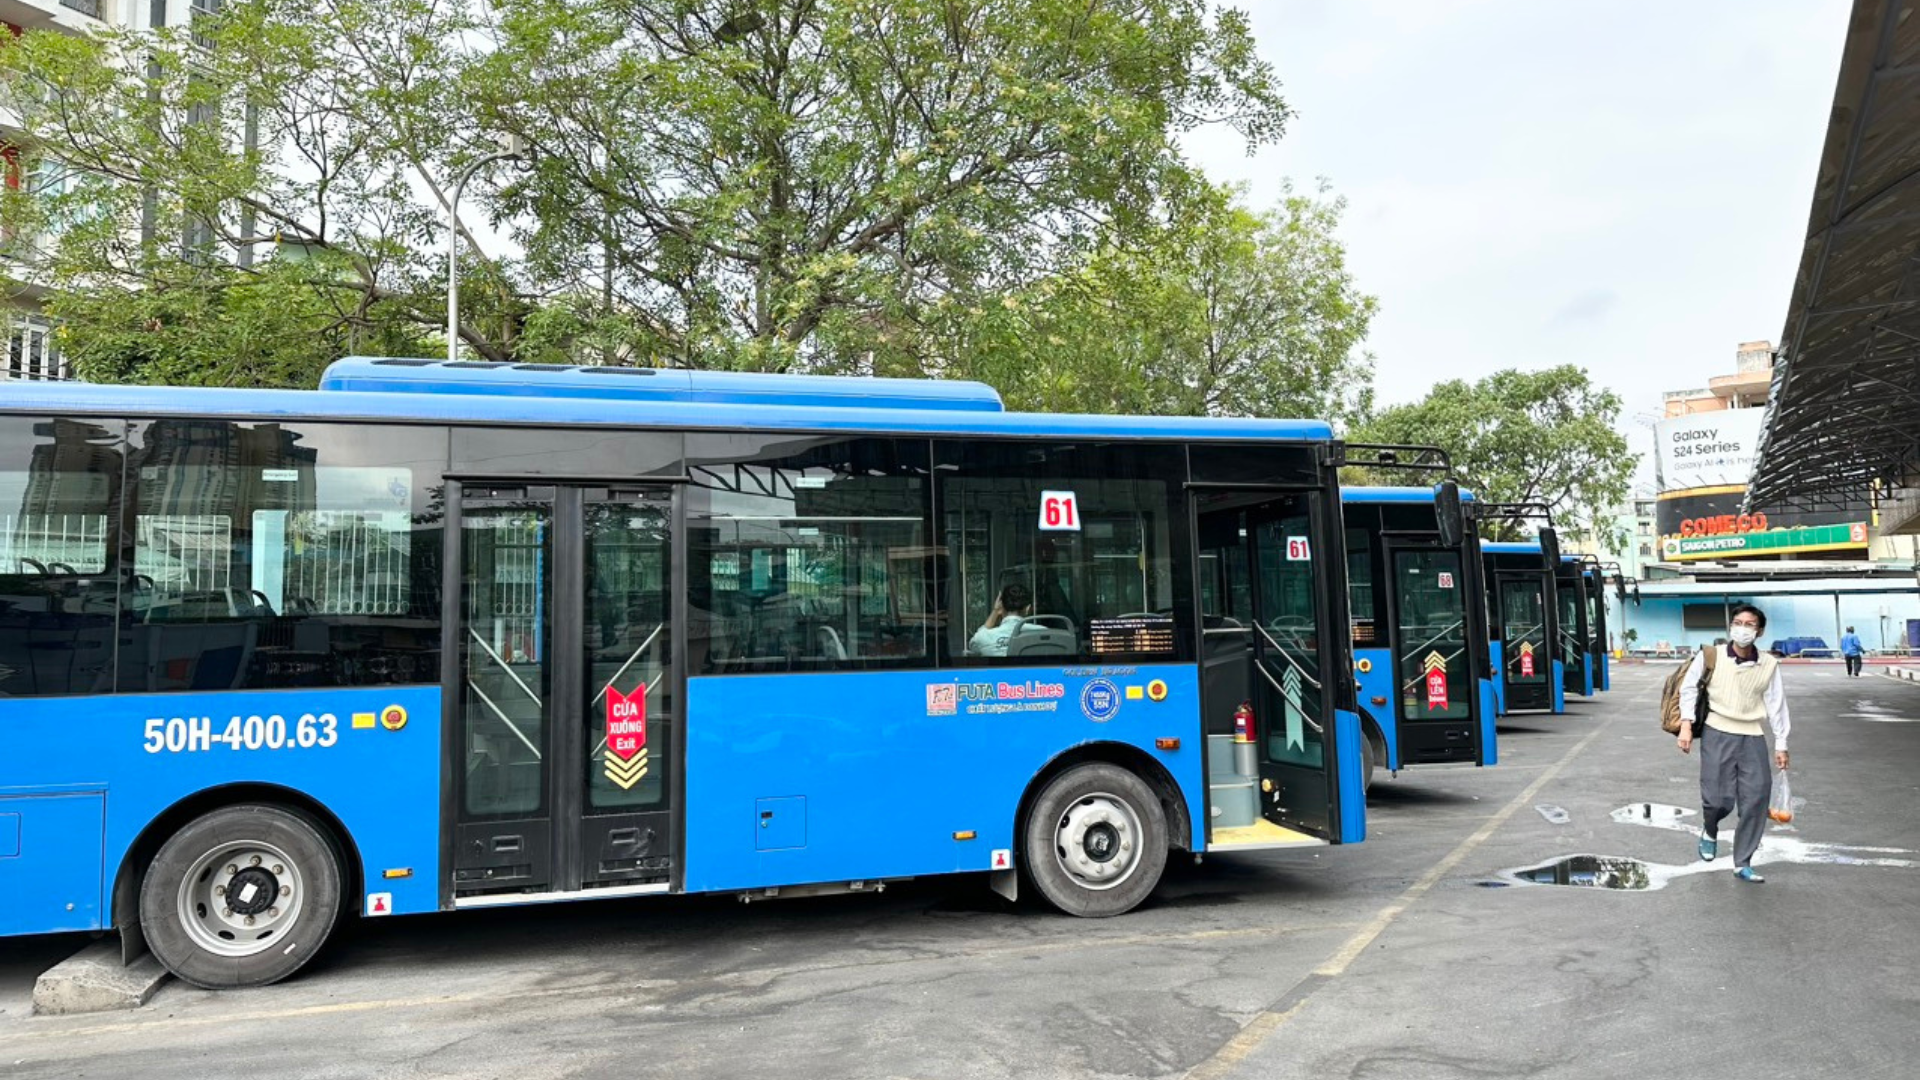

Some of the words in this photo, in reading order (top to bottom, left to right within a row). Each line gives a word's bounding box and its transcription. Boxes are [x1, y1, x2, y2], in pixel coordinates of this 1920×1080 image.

[1672, 429, 1718, 443] Galaxy
[1674, 445, 1692, 458] S24
[1695, 441, 1741, 455] Series
[1674, 460, 1703, 471] Galaxy
[1045, 497, 1074, 527] 61
[1680, 511, 1768, 537] COMECO
[1289, 540, 1308, 558] 61
[1682, 540, 1715, 552] SAIGON
[1715, 538, 1746, 549] PETRO
[957, 683, 996, 701] FUTA
[998, 682, 1025, 699] Bus
[1026, 680, 1065, 698] Lines
[613, 698, 638, 717] CỬA
[143, 713, 338, 753] 50H-400.63
[610, 717, 642, 734] XUỐNG
[616, 737, 636, 749] Exit
